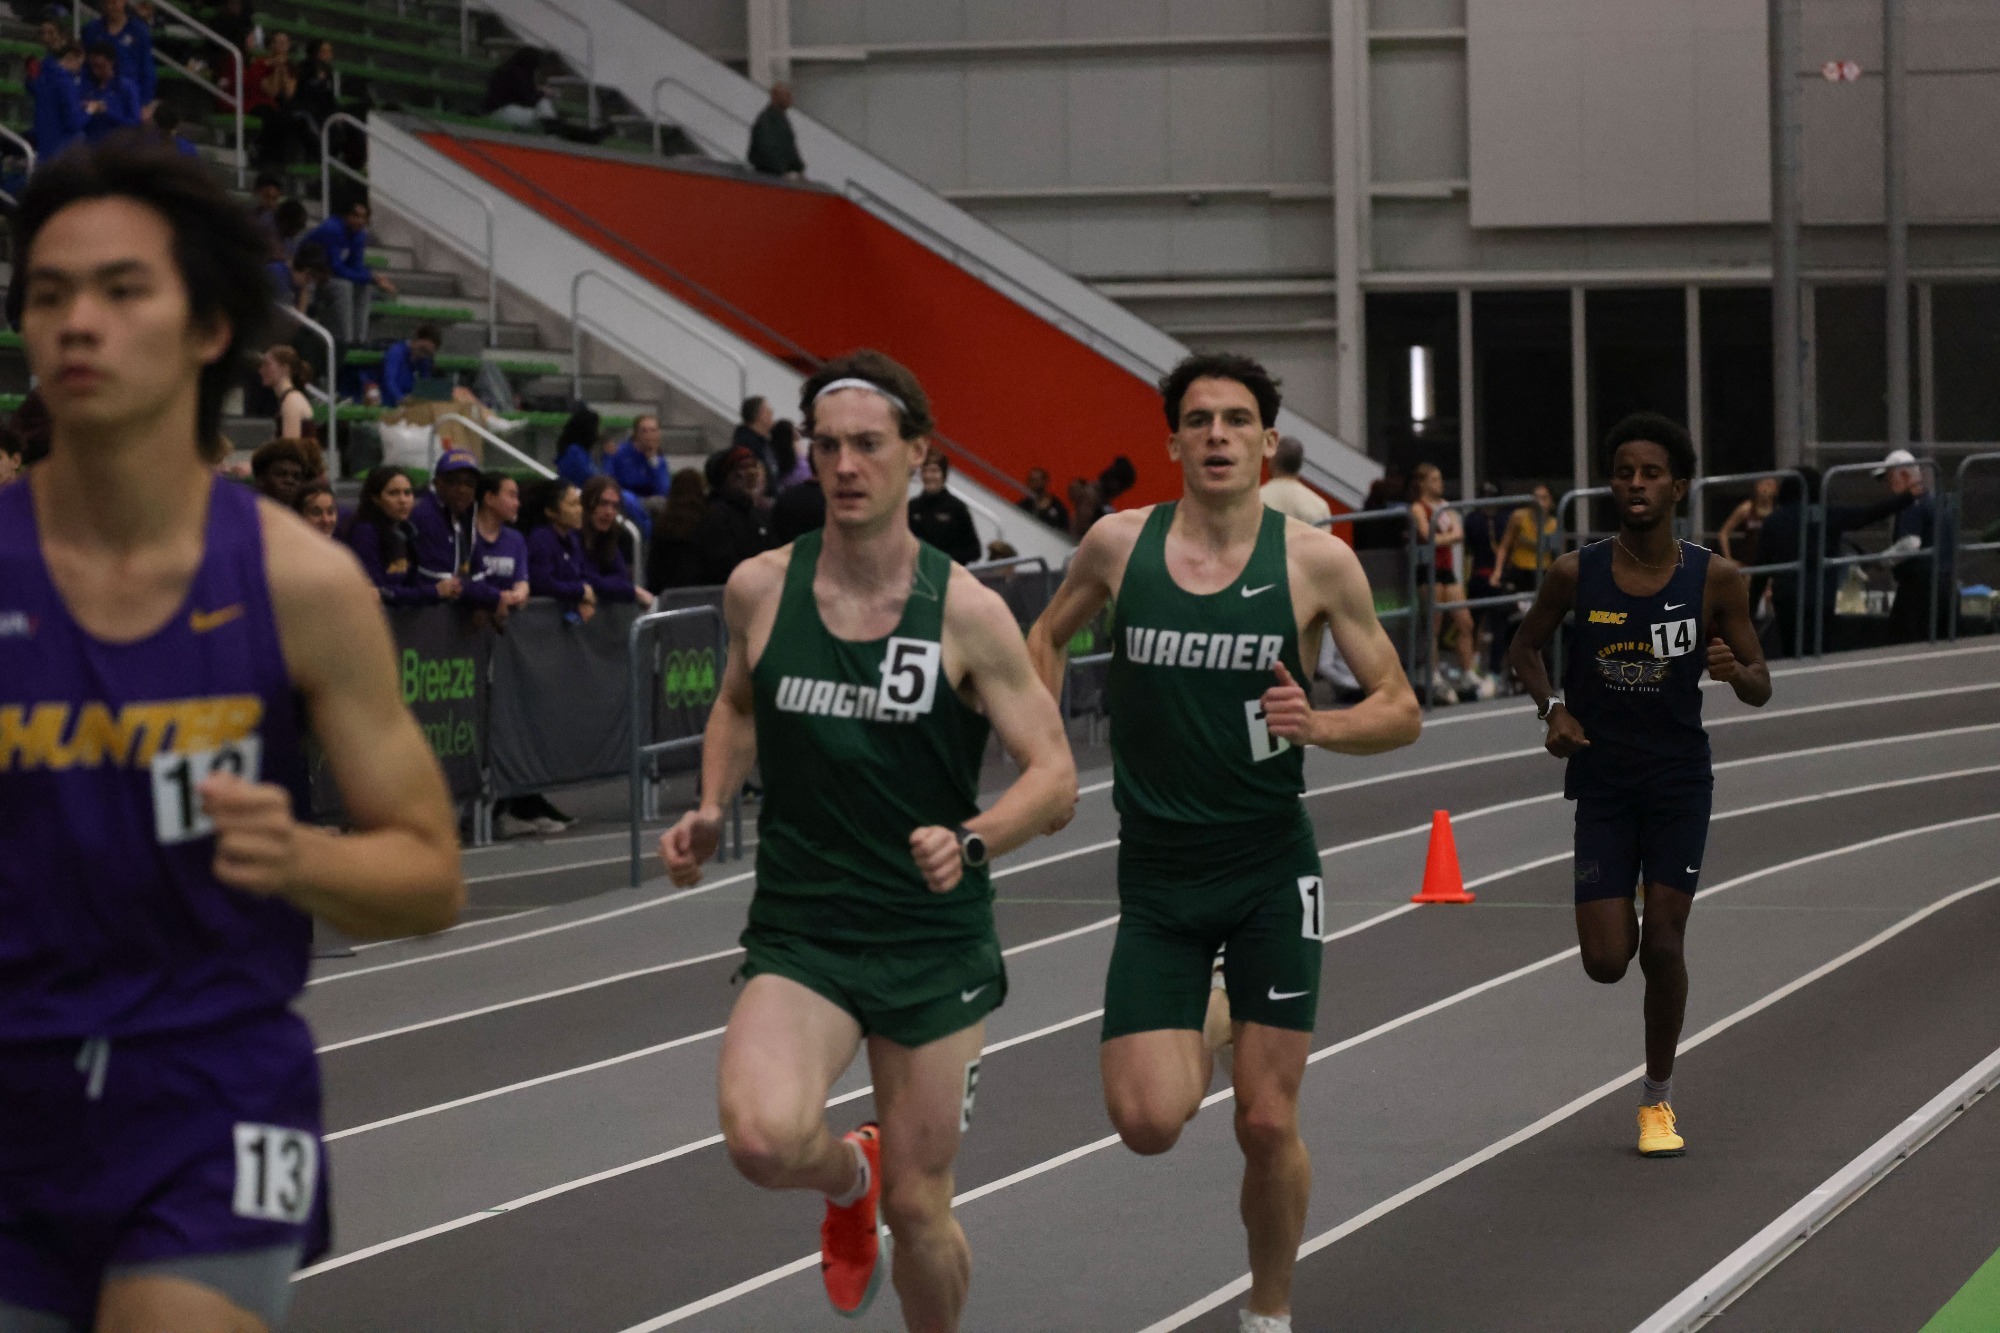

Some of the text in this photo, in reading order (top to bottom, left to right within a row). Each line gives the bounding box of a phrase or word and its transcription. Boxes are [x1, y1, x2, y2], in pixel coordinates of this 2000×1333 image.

[1125, 626, 1284, 671] WAGNER
[1597, 641, 1635, 658] COPPIN
[1654, 621, 1692, 656] 14
[775, 674, 918, 723] WAGN
[887, 643, 927, 705] 5
[1307, 876, 1319, 936] 1
[248, 1134, 305, 1214] 13
